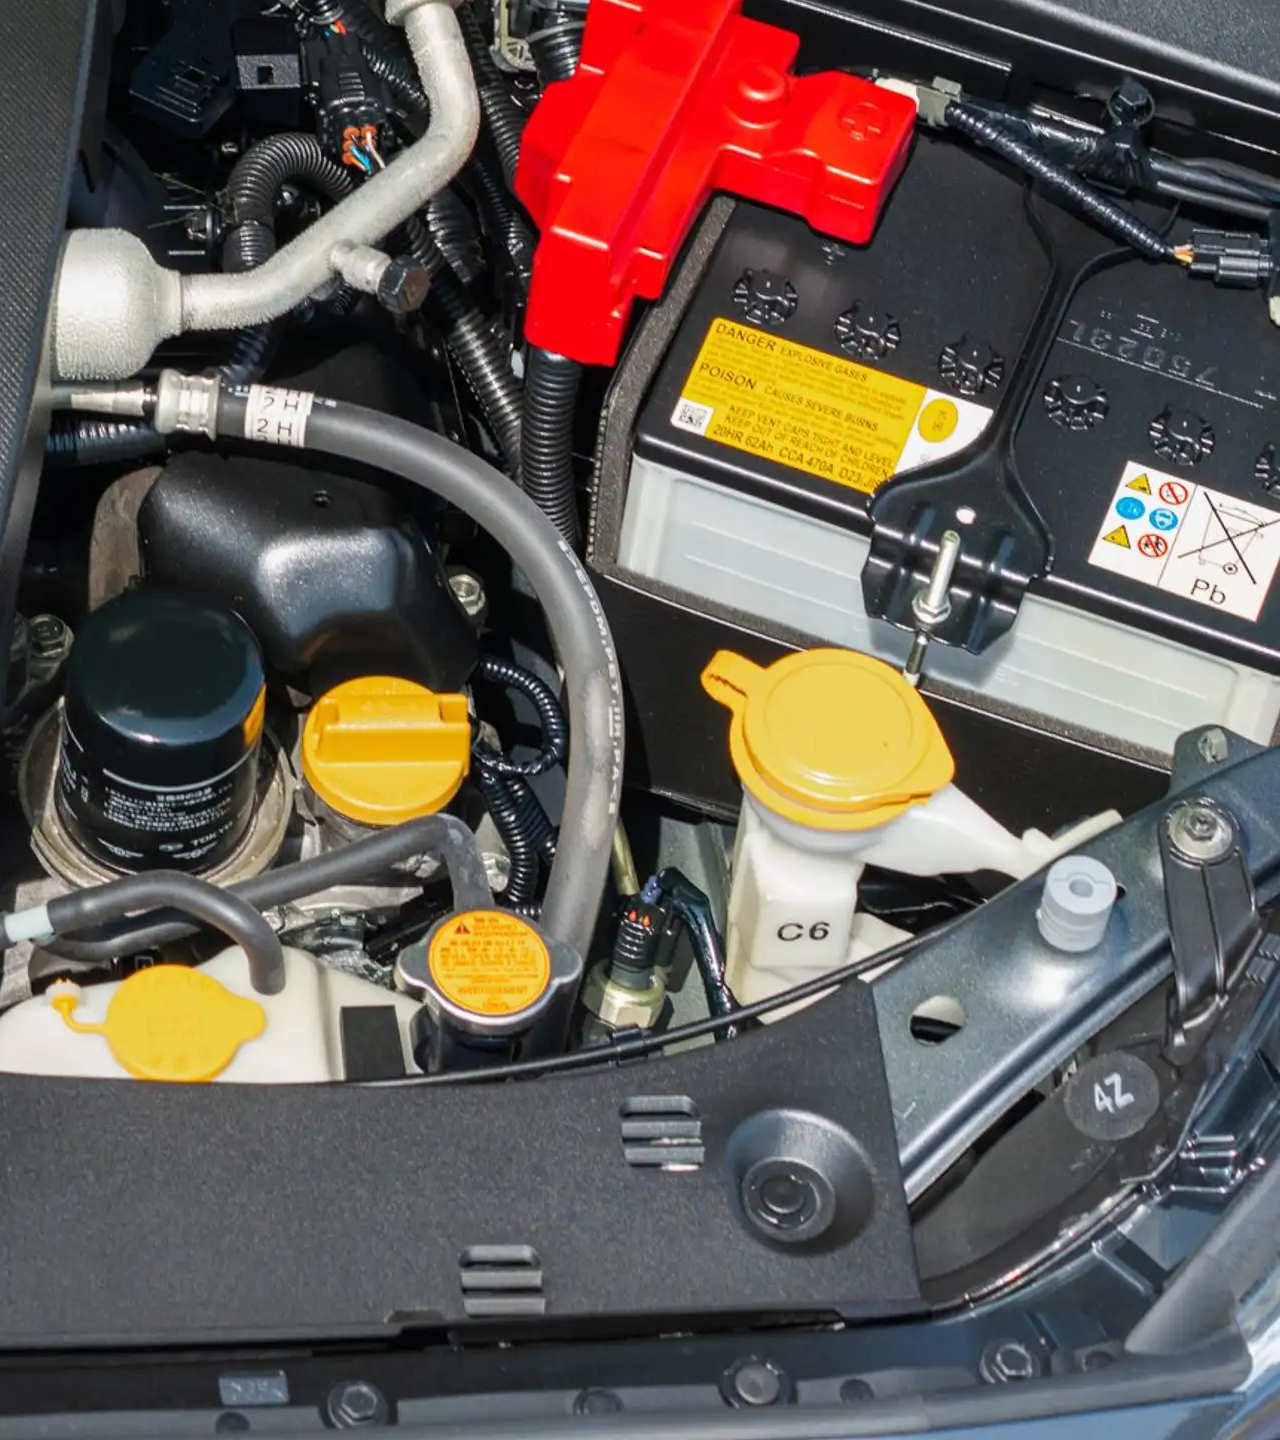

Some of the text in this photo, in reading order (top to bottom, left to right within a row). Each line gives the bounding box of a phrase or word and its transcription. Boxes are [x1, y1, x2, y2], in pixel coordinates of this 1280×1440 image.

[715, 323, 777, 352] DANGER
[779, 346, 833, 371] EXPLOSIVE
[834, 363, 868, 383] GASES
[698, 362, 757, 391] POISON
[763, 385, 804, 407] CAUSES
[804, 396, 843, 418] SEVERE
[844, 412, 879, 432] BURNS
[712, 424, 743, 444] 20HR
[744, 433, 775, 453] 62Ah
[778, 446, 805, 466] CCA
[728, 405, 755, 422] KEEP
[756, 412, 782, 429] VENT
[783, 421, 810, 439] CAPS
[842, 441, 863, 457] AND
[788, 434, 824, 454] REACH
[1190, 577, 1228, 606] Pb
[776, 919, 831, 944] C6
